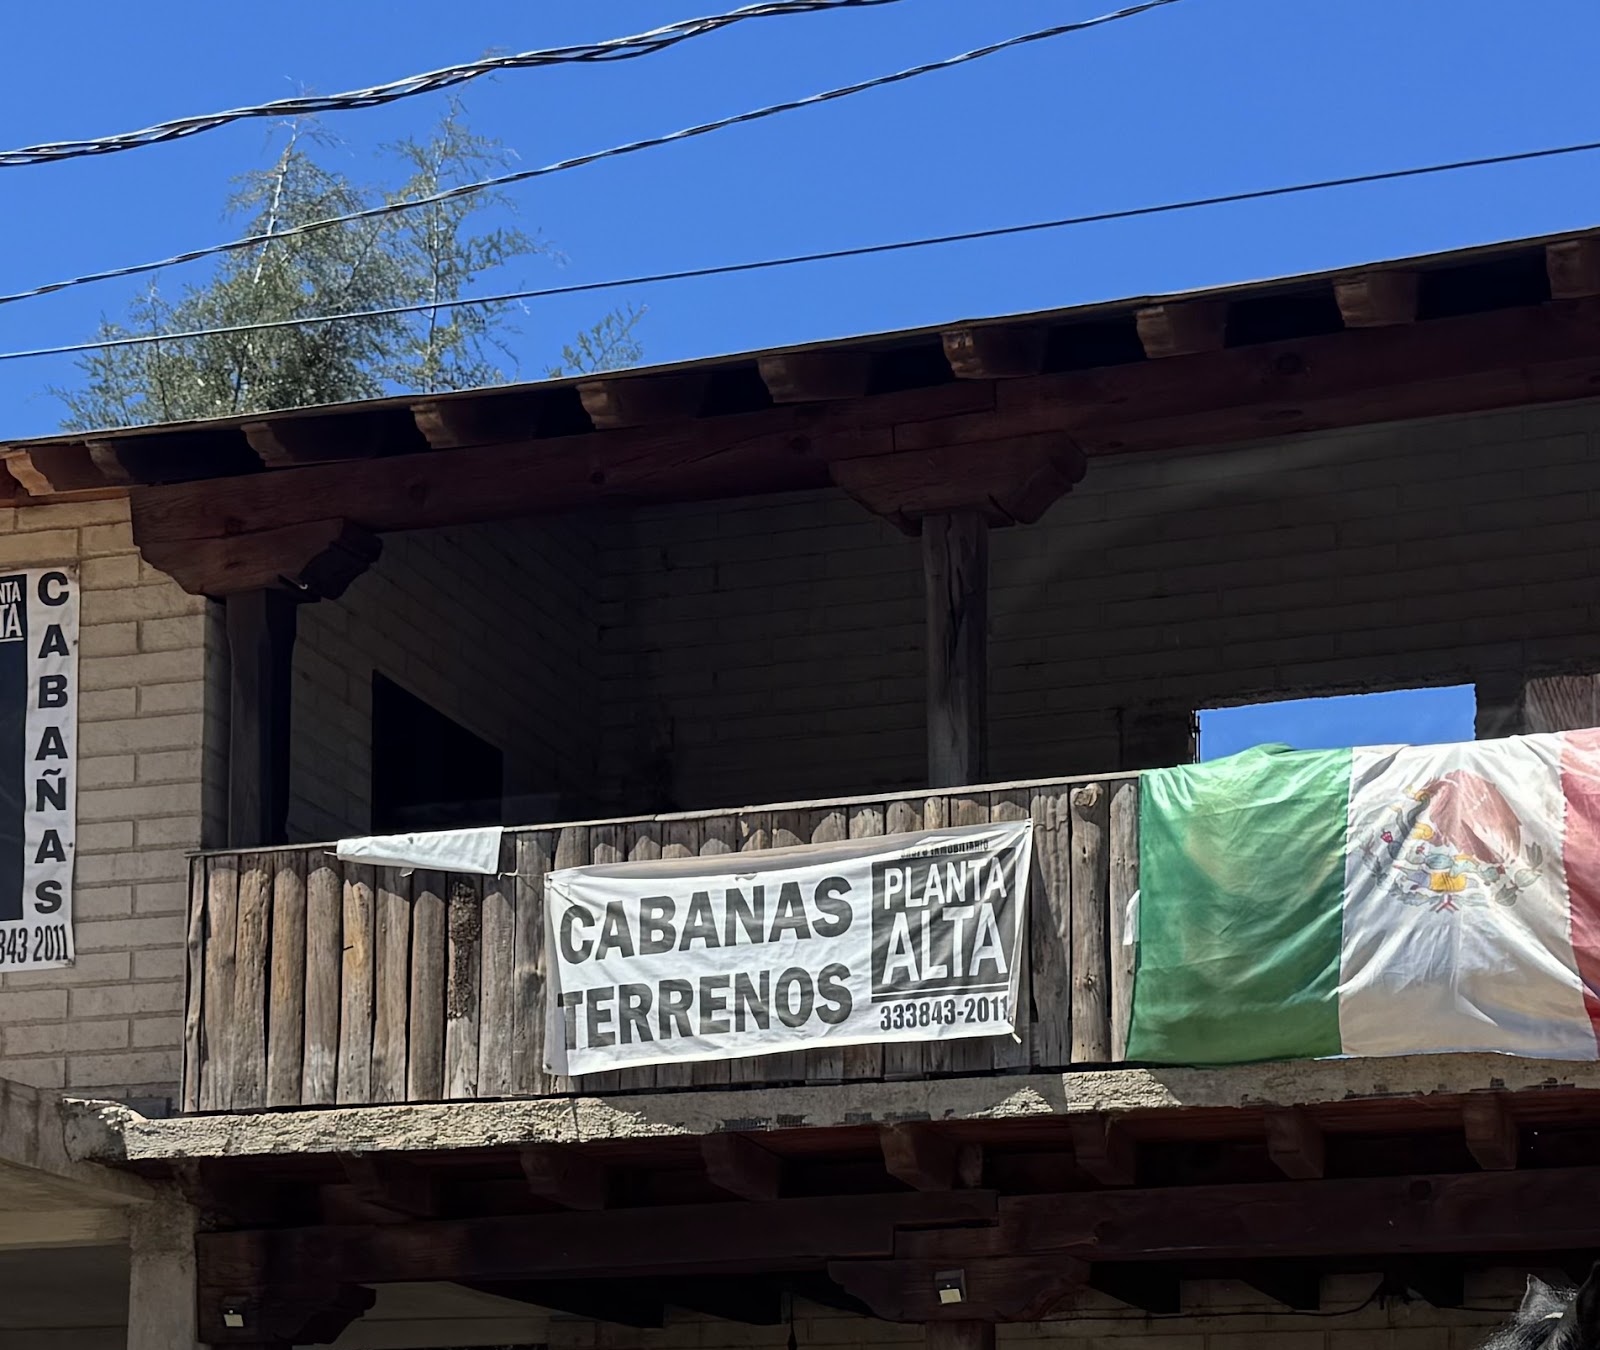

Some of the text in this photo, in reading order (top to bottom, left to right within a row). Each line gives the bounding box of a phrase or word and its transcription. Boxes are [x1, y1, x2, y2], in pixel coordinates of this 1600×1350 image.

[34, 571, 70, 914] CABAÑAS
[560, 873, 853, 964] CABAÑAS
[884, 857, 1007, 910] PLANTA
[33, 923, 68, 962] 2011
[882, 903, 1008, 985] ALTA
[557, 962, 853, 1051] TERRENOS
[880, 996, 1007, 1031] 333843-2011
